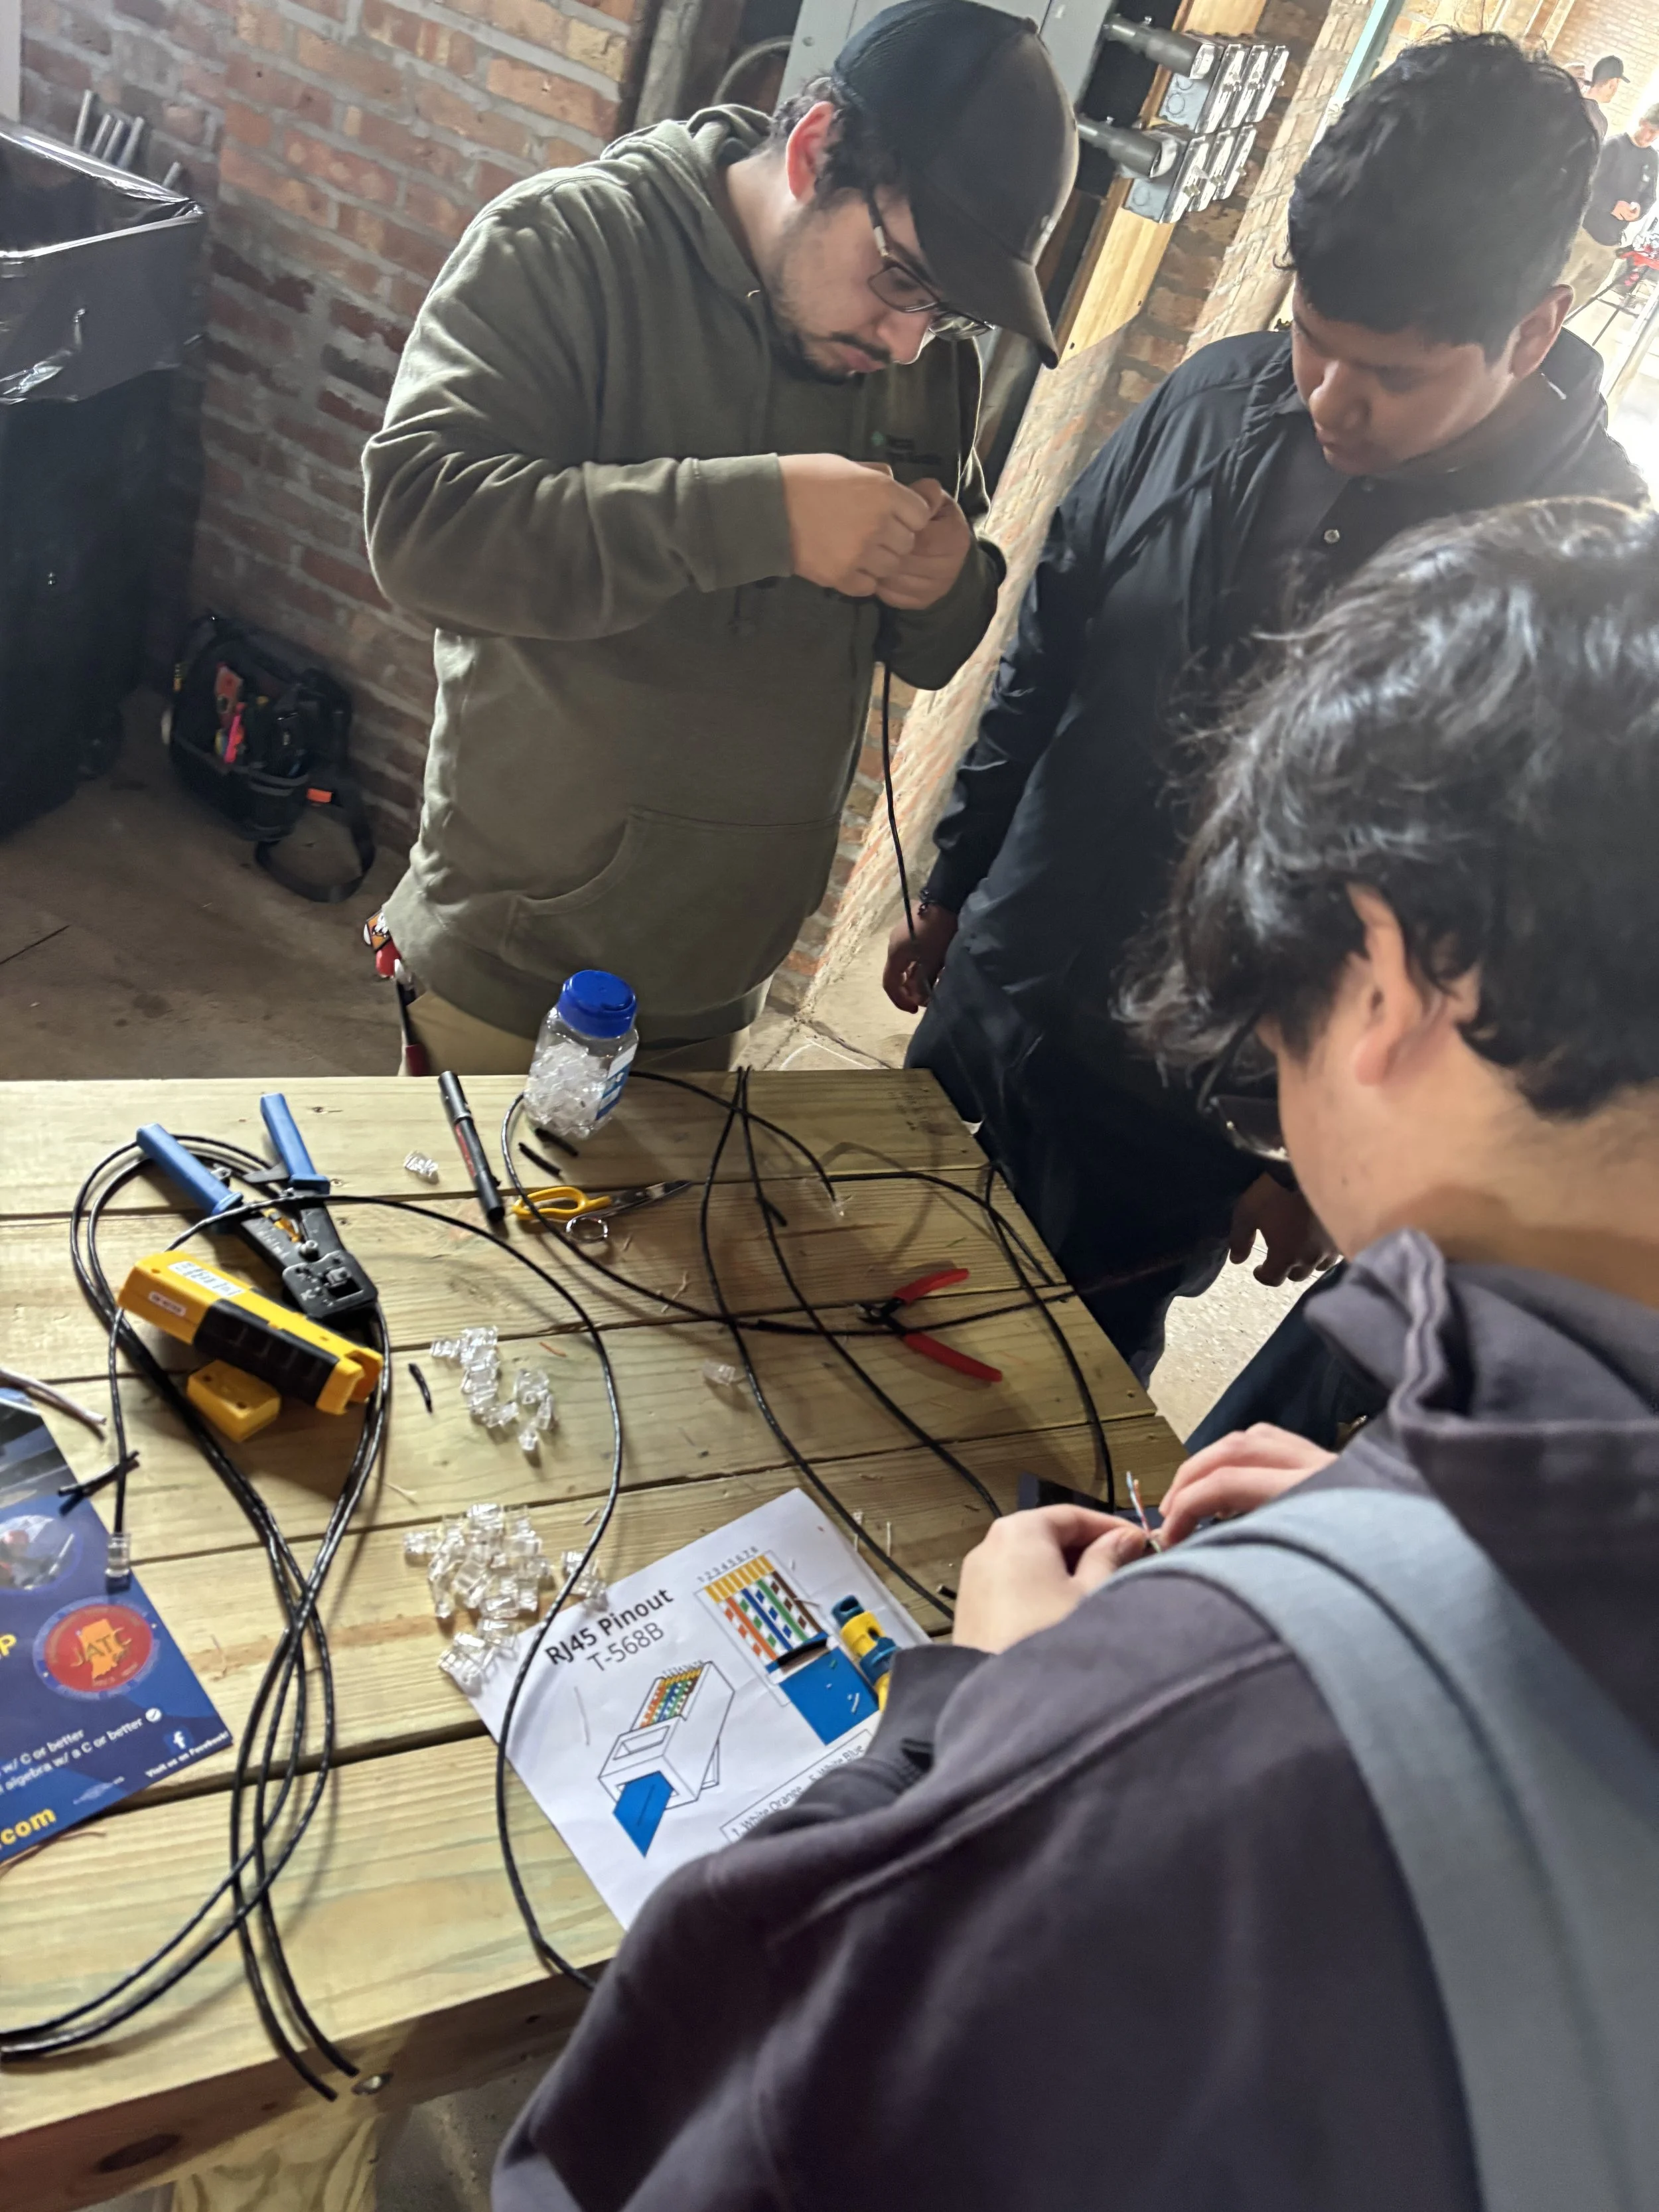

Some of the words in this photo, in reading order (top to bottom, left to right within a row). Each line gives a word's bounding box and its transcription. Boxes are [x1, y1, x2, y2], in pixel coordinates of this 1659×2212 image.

[70, 1626, 133, 1667] JATC
[544, 1627, 597, 1666] RJ45
[597, 1588, 674, 1637] Pinout
[586, 1621, 665, 1672] T-568B
[5, 1761, 52, 1791] algebra
[81, 1741, 94, 1753] C
[93, 1735, 107, 1749] or
[107, 1718, 143, 1741] better
[19, 1752, 31, 1765] C
[33, 1746, 46, 1759] or
[46, 1729, 85, 1753] better
[740, 1808, 769, 1830] White
[842, 1745, 863, 1762] Blue
